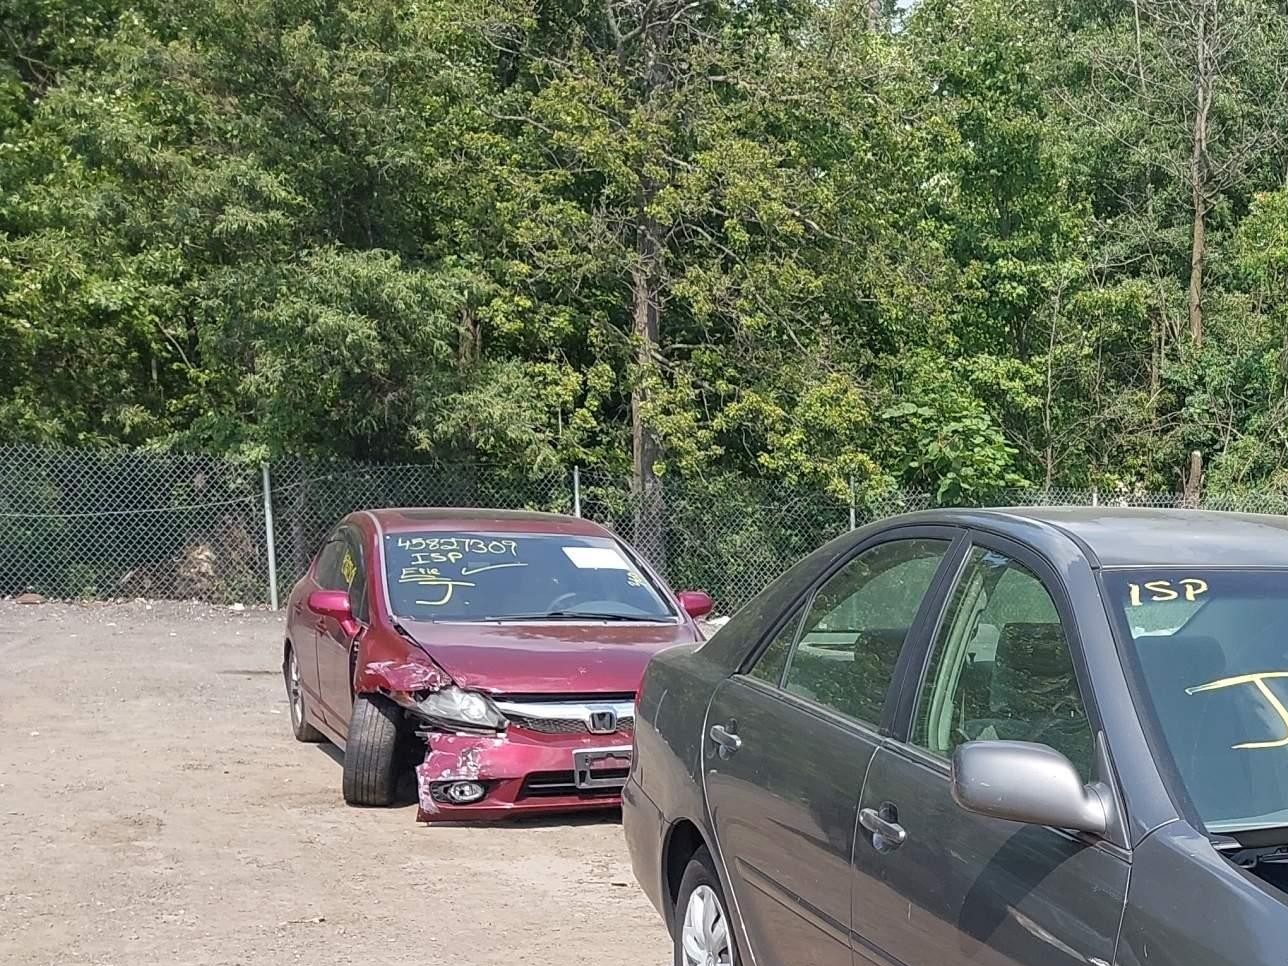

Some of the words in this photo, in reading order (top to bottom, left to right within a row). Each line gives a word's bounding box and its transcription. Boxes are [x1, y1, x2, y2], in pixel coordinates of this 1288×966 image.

[397, 537, 517, 556] 45827309
[411, 552, 463, 564] ISP
[1128, 578, 1209, 606] ISP
